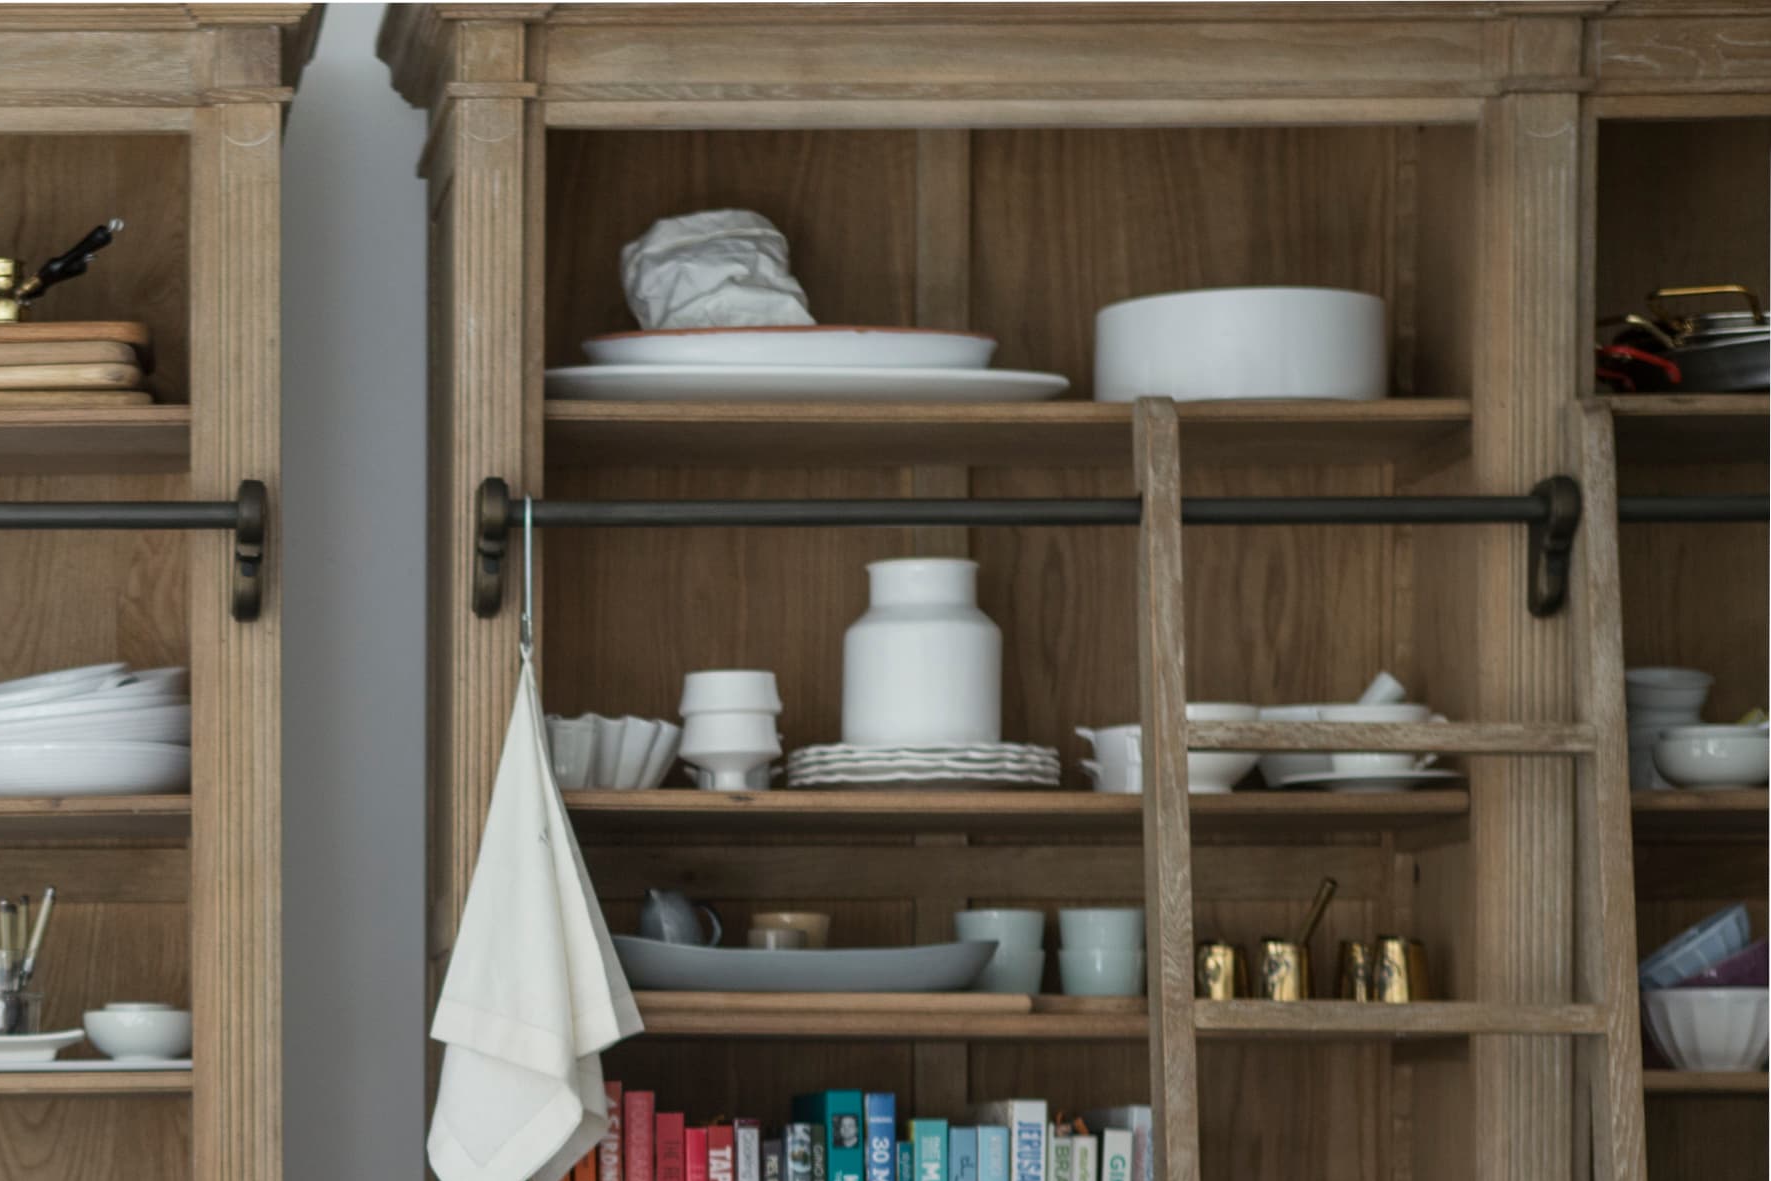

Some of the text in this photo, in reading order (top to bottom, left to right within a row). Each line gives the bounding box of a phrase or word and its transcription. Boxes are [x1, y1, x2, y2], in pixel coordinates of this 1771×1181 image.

[664, 1139, 680, 1159] THE
[813, 1144, 825, 1177] GINO
[872, 1136, 890, 1163] 30
